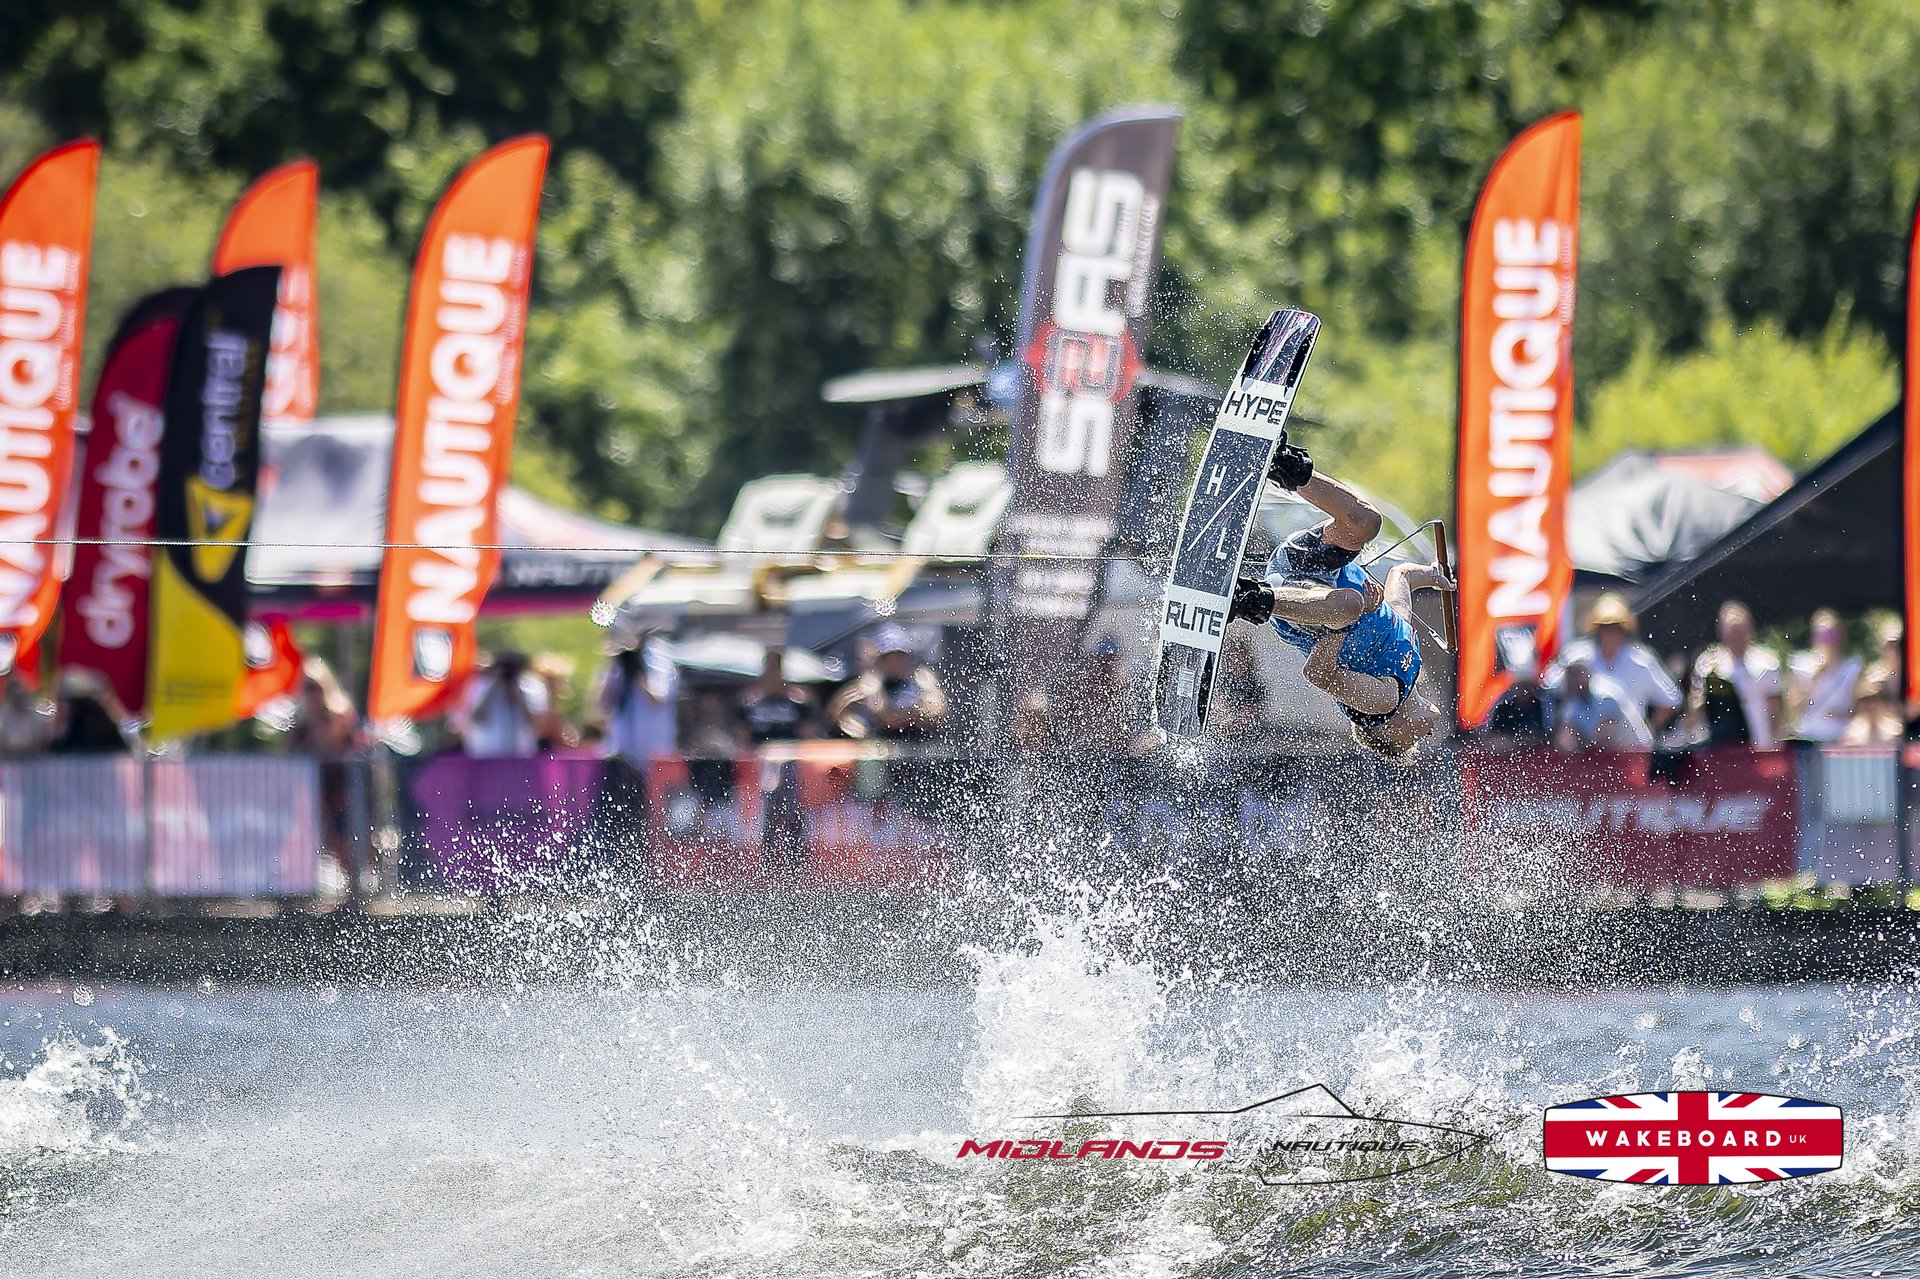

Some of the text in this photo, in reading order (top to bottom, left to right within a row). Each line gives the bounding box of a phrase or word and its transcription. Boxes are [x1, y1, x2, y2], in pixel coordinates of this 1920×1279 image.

[406, 233, 518, 623] NAUTIQUE
[1225, 390, 1288, 427] HYPE
[1488, 219, 1560, 617] NAUTIQUE
[1206, 464, 1226, 497] H
[78, 390, 166, 649] dryrobe
[1216, 526, 1229, 561] L
[1166, 600, 1224, 637] RLITE
[1494, 794, 1772, 835] UTIQUE
